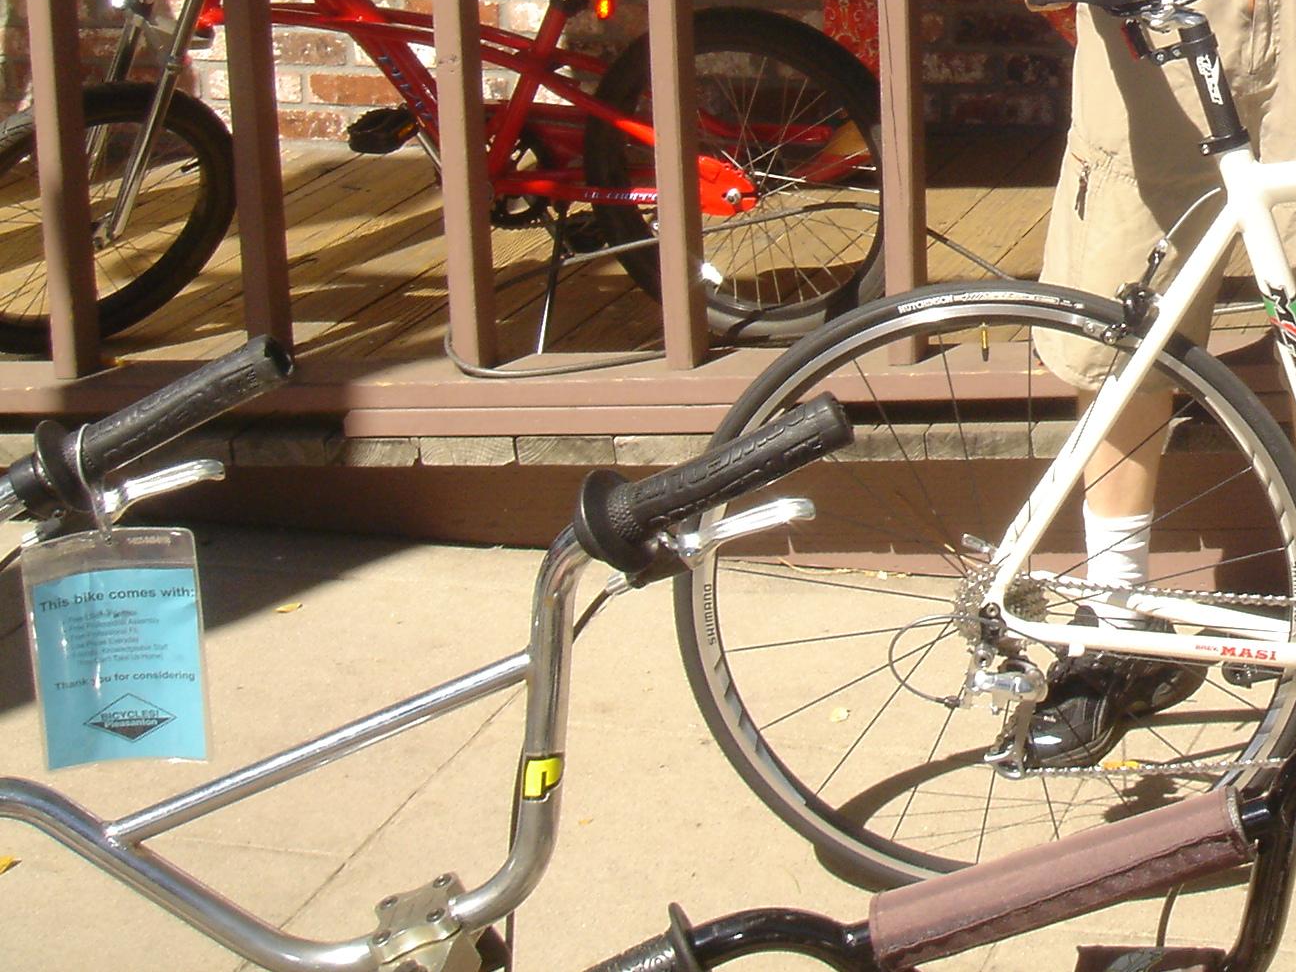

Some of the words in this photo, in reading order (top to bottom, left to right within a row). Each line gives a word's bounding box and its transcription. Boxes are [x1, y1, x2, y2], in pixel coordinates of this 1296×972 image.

[897, 294, 954, 314] HUTCHINSON
[39, 597, 69, 613] This
[74, 591, 104, 605] bike
[108, 588, 156, 599] comes
[161, 587, 195, 597] with:
[1220, 645, 1277, 661] MASI
[55, 679, 89, 691] Thank
[114, 673, 129, 682] for
[133, 671, 195, 681] considering
